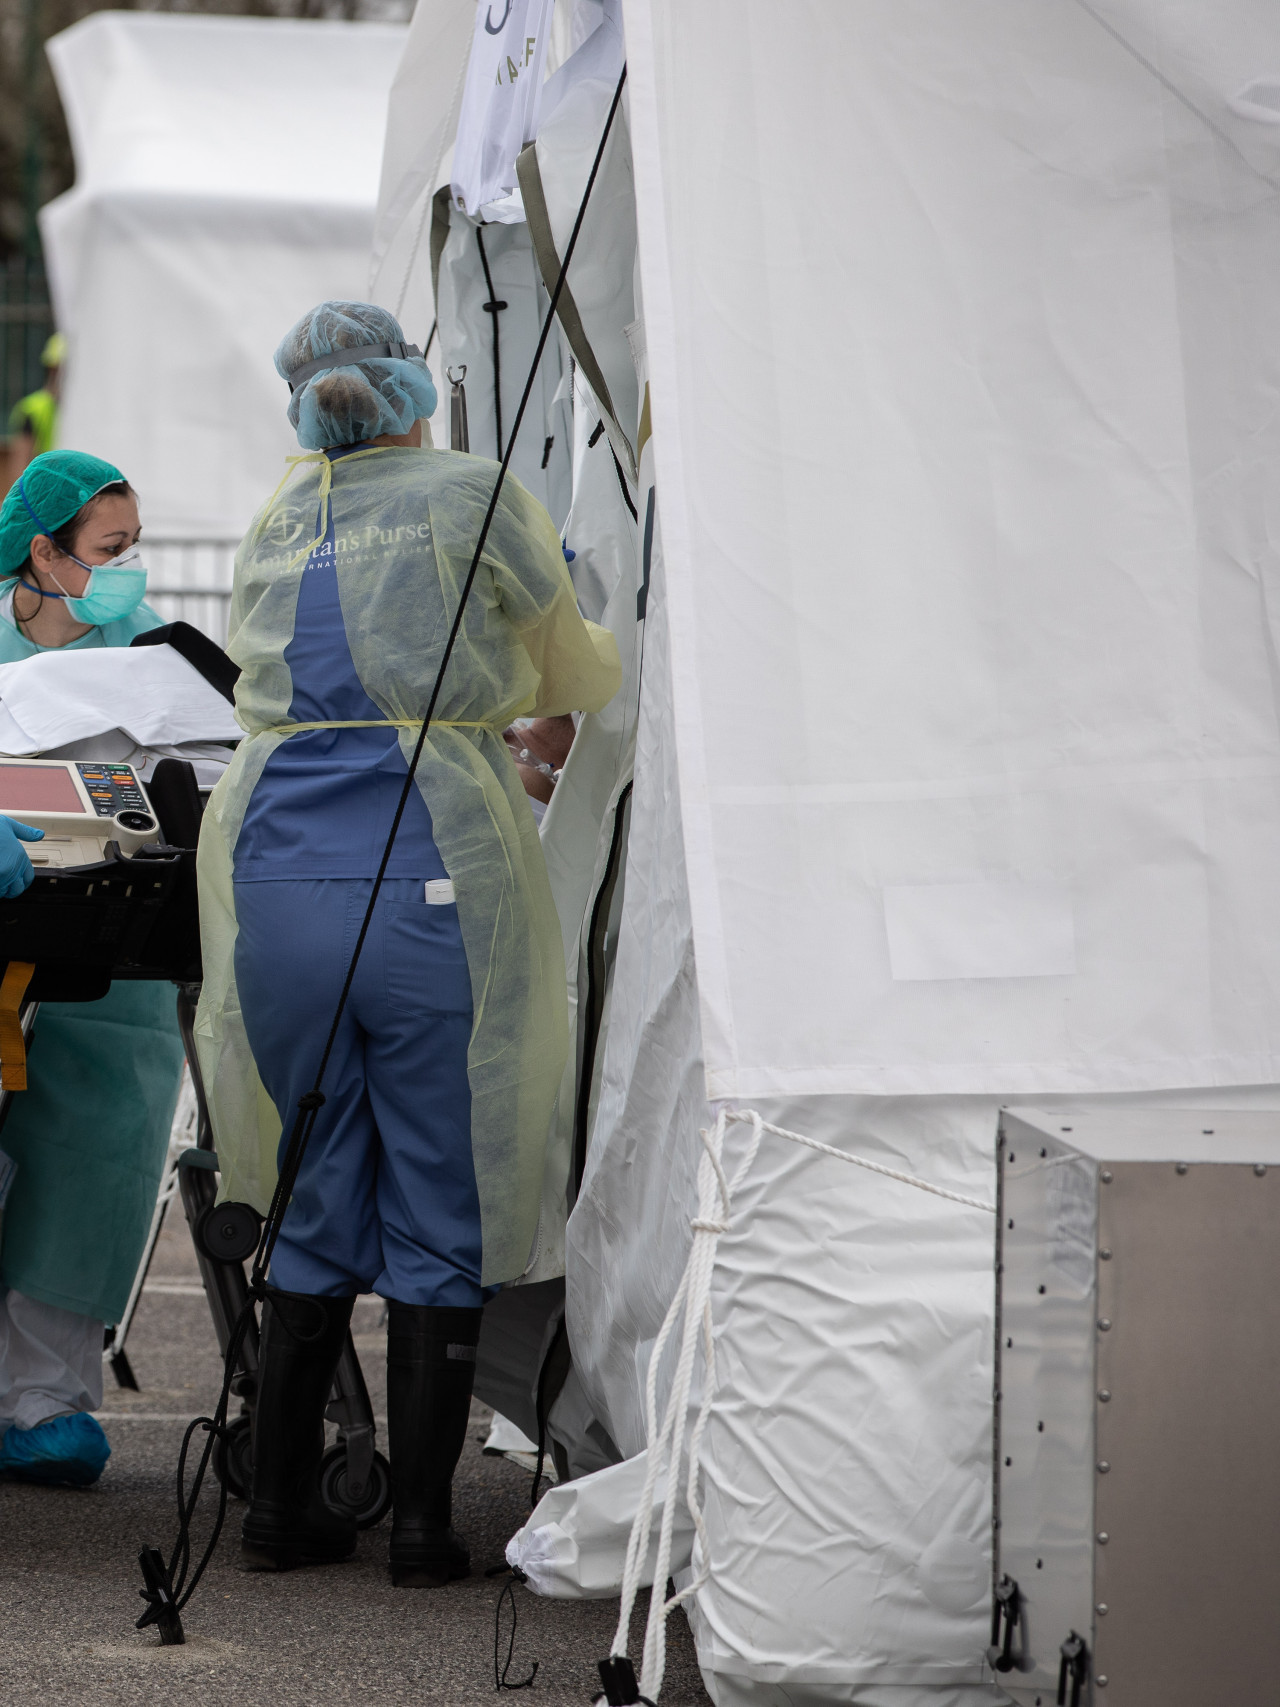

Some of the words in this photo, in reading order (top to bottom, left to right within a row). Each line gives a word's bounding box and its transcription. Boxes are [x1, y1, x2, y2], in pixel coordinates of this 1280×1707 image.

[250, 530, 360, 572] maritan's
[365, 522, 431, 548] Purse
[383, 545, 431, 559] RELIEF
